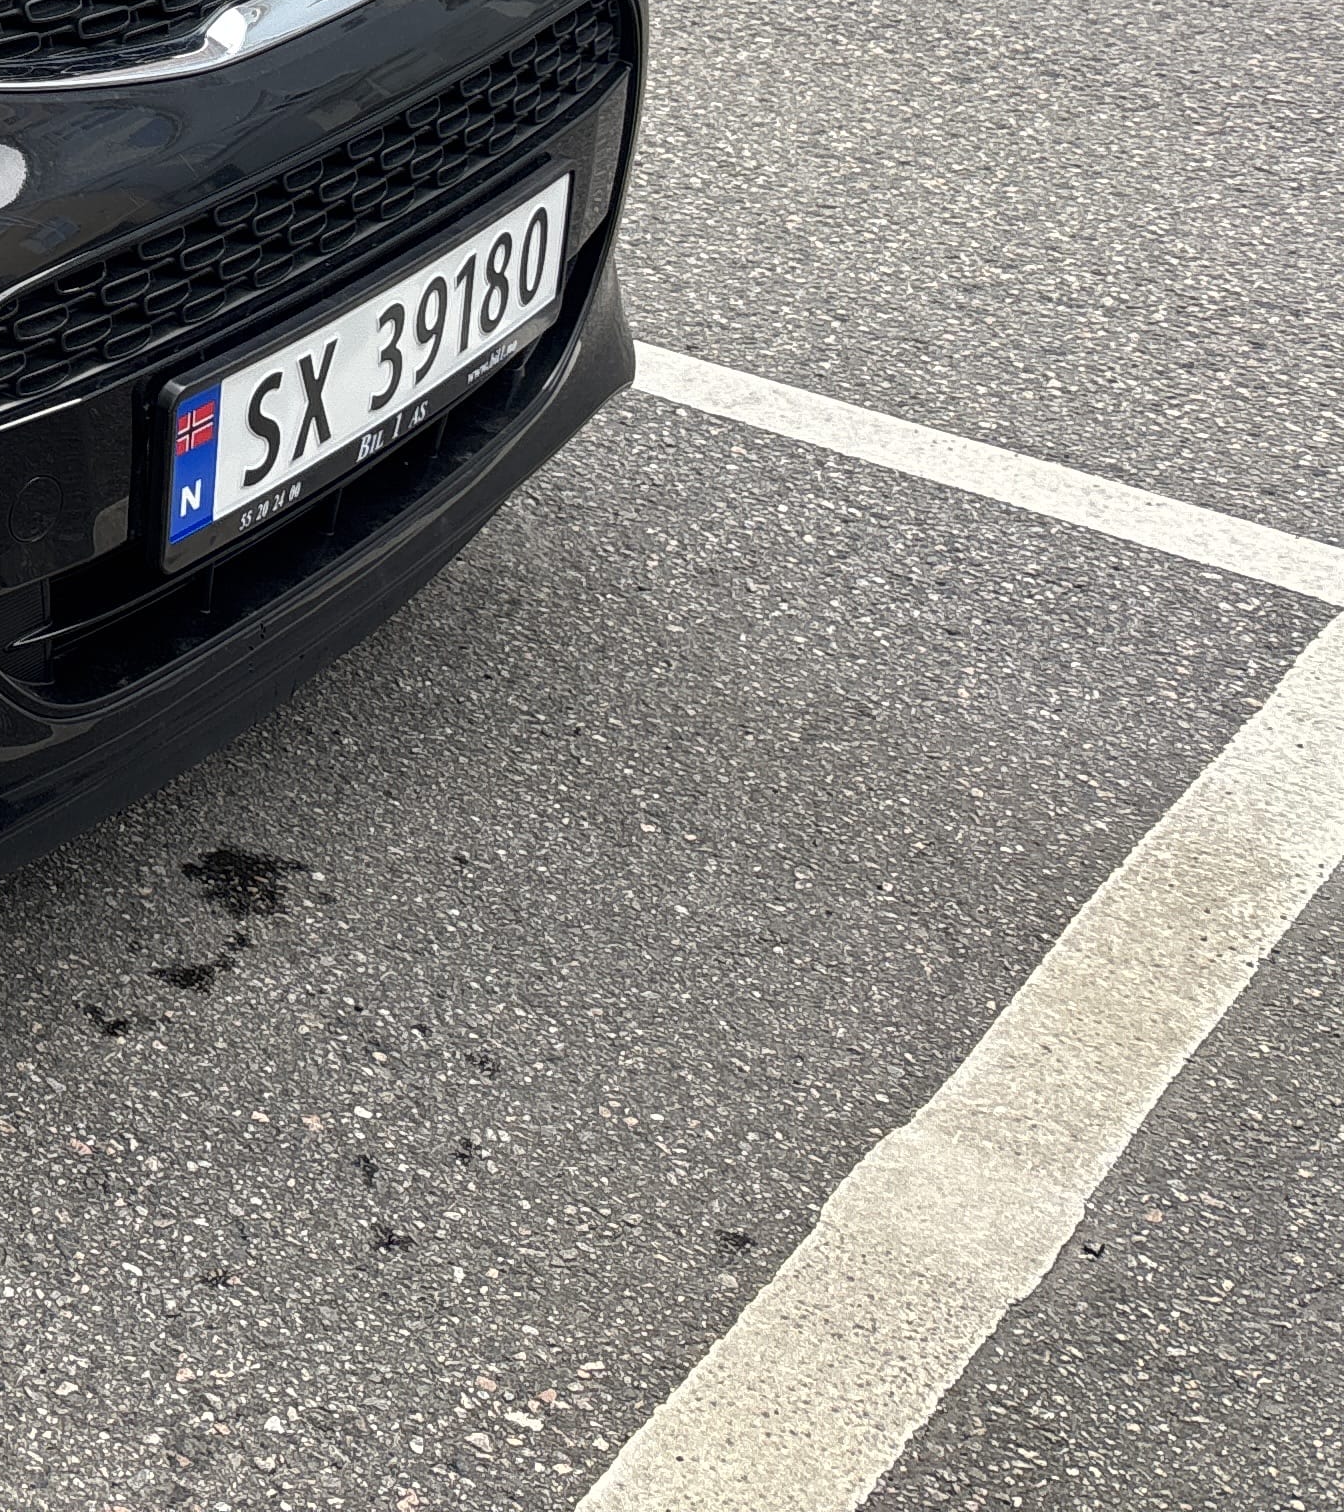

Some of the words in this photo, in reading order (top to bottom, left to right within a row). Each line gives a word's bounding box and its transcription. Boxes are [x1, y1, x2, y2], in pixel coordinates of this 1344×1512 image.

[240, 337, 339, 488] SX
[368, 205, 549, 412] 39180
[179, 479, 202, 517] N
[255, 499, 270, 521] 20
